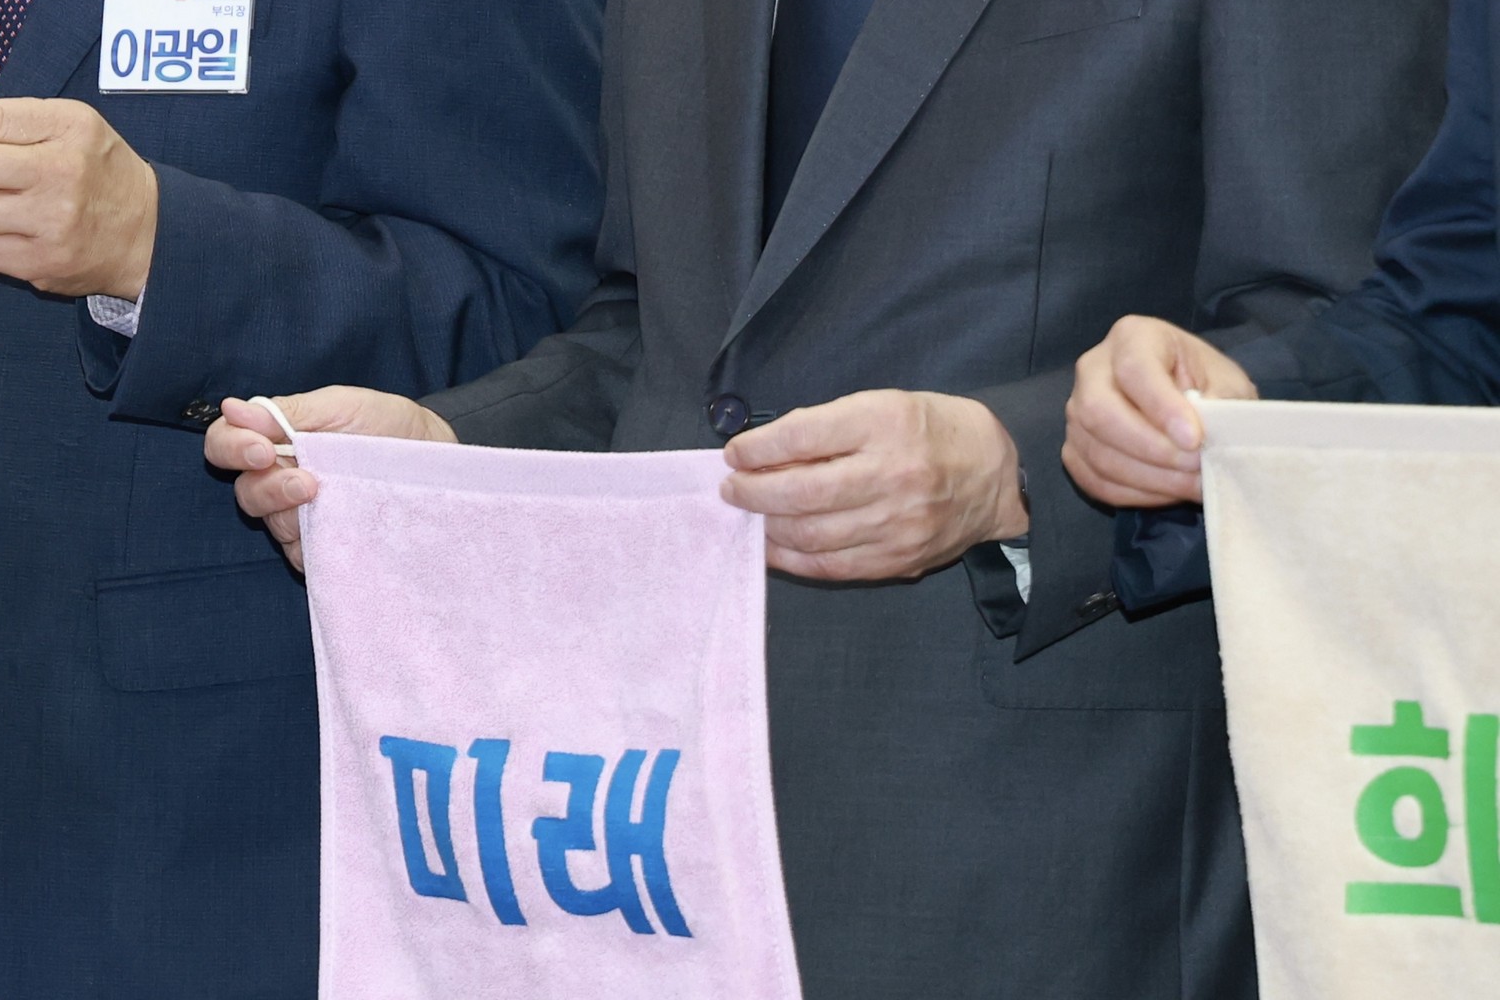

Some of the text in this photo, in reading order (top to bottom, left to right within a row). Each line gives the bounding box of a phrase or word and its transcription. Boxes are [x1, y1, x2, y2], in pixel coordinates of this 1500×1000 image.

[212, 5, 245, 17] 부의장
[110, 28, 238, 83] 이광일
[379, 735, 694, 938] 미래
